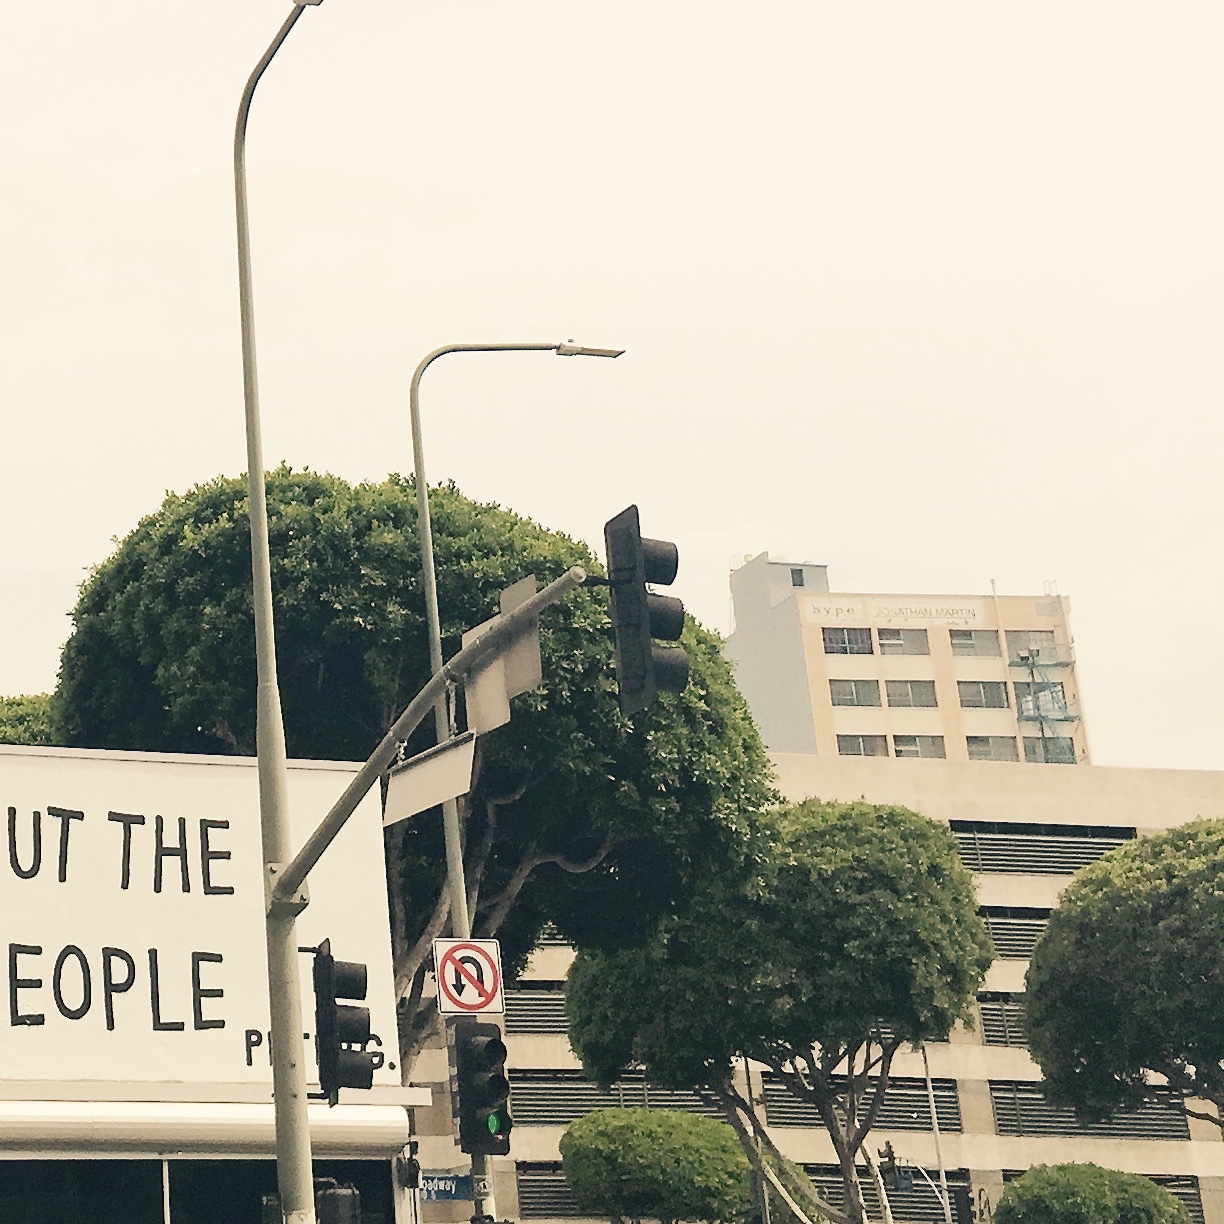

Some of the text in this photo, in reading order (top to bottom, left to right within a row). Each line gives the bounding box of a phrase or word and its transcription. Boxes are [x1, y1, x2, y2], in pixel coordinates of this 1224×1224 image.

[811, 603, 856, 618] hype
[876, 605, 976, 619] JONATHAN MARTIN
[107, 810, 235, 896] THE
[420, 1177, 457, 1194] oadway
